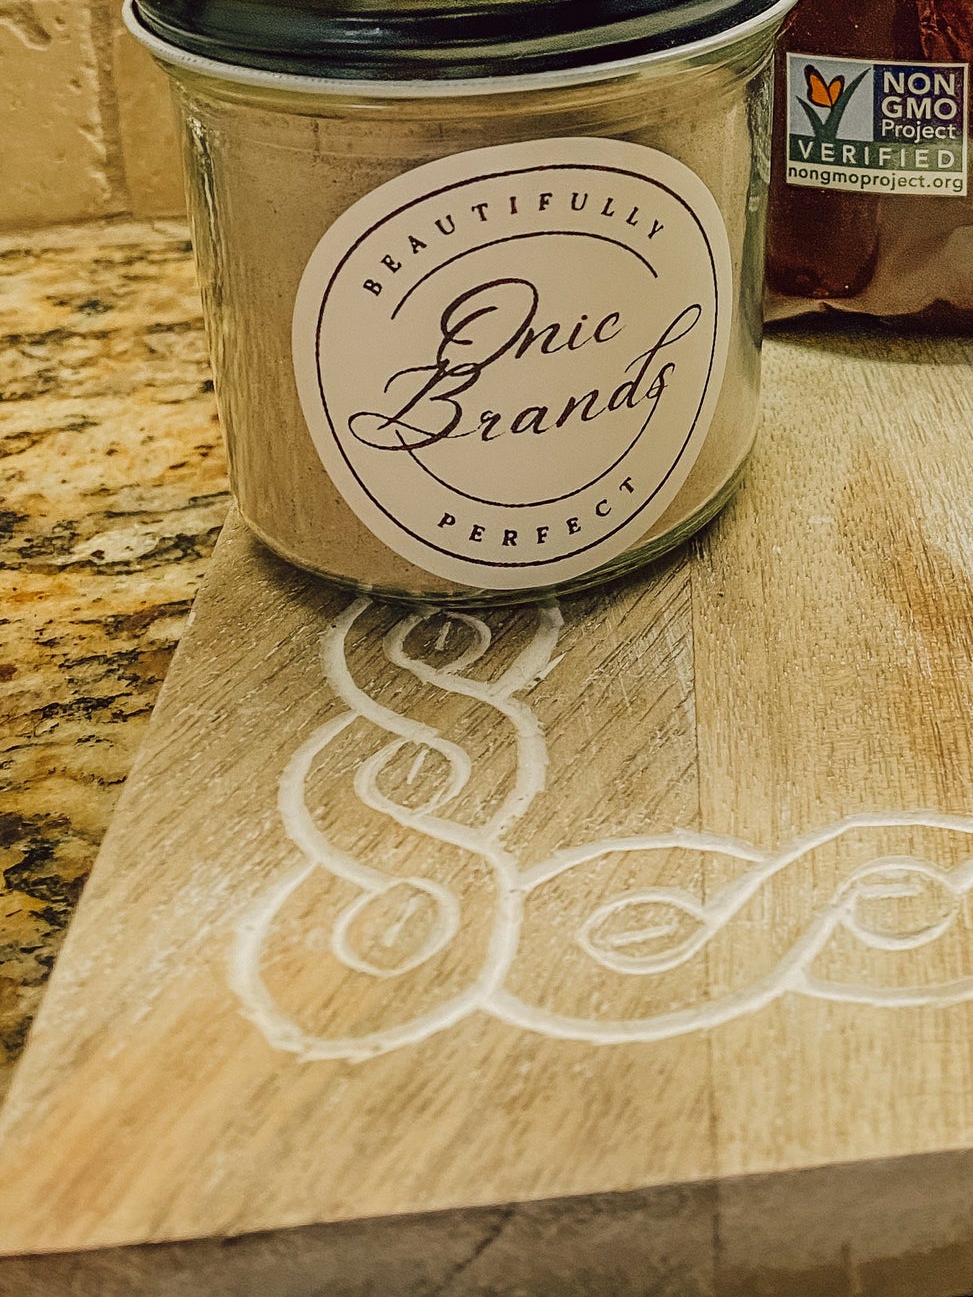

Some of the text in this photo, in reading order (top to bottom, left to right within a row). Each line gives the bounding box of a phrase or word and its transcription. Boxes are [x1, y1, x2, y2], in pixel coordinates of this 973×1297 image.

[883, 71, 955, 96] NON
[881, 96, 957, 120] GMO
[881, 119, 956, 143] Project
[798, 140, 955, 169] VERIFIED
[788, 166, 963, 192] nongmoproject.org
[363, 192, 665, 296] BEAUTIFULLY
[348, 304, 702, 451] Brands
[438, 476, 636, 547] PERFECT
